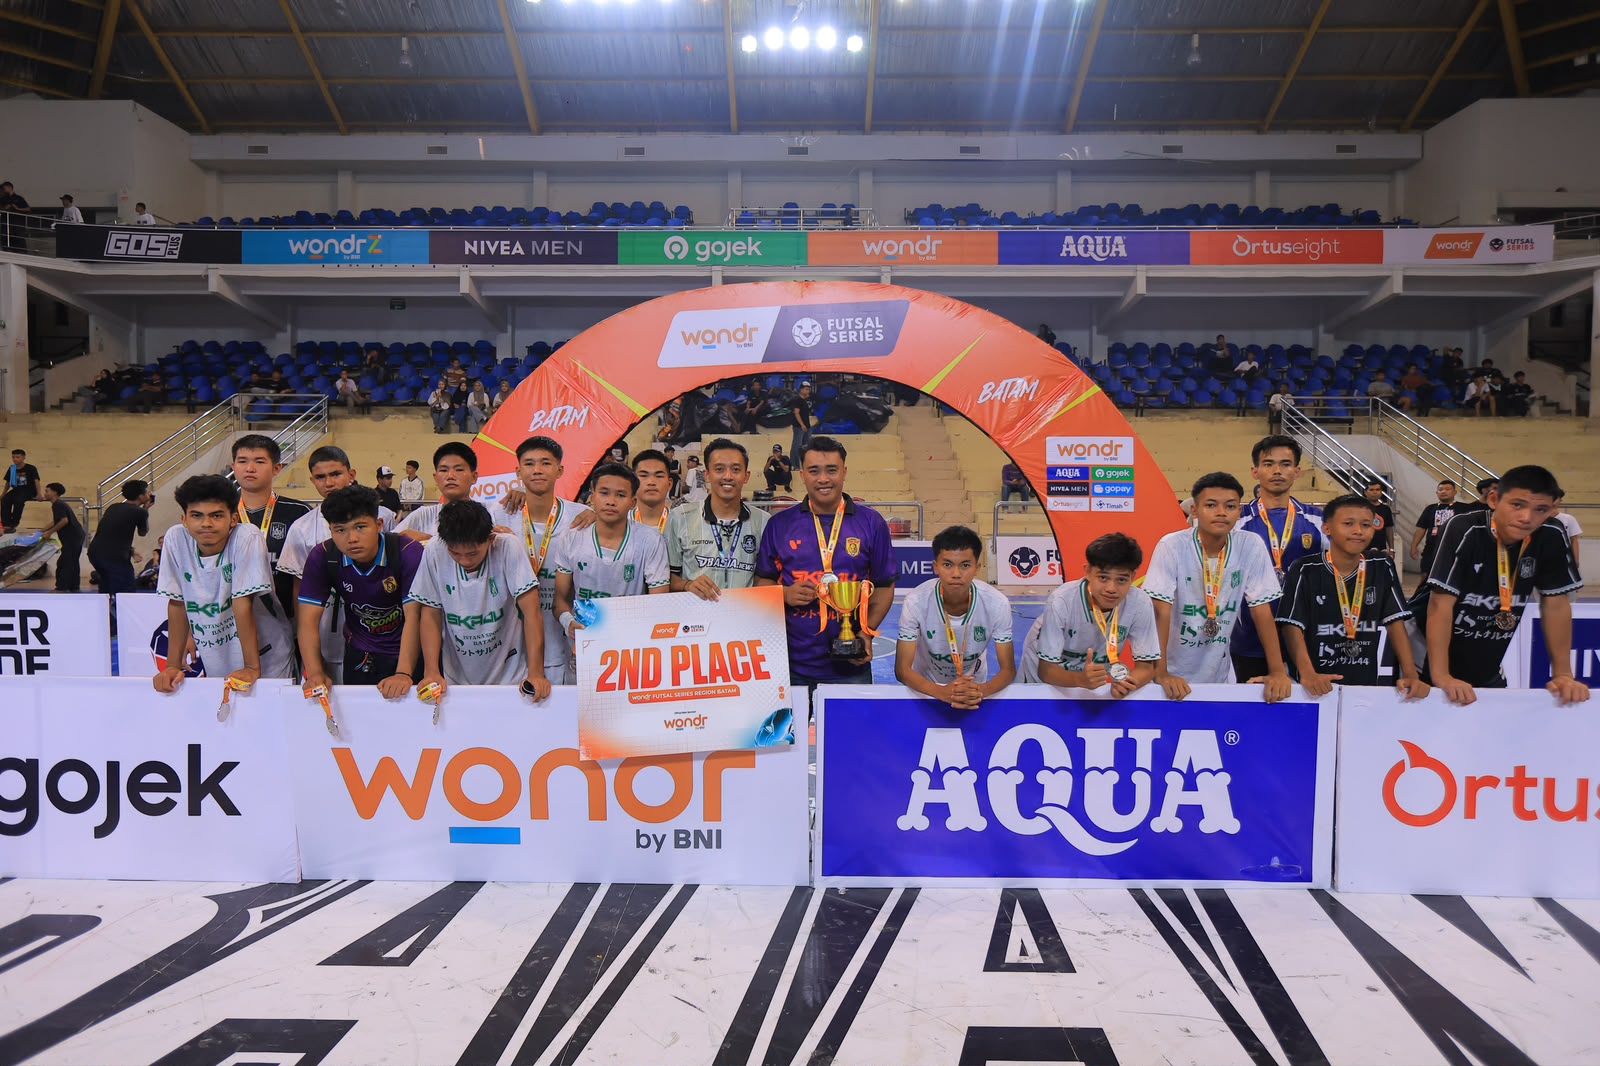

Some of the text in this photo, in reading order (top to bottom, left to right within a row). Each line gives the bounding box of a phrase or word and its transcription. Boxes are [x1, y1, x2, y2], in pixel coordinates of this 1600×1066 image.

[106, 233, 170, 256] GOS
[167, 236, 181, 256] PLUS
[464, 240, 583, 255] NIVEA MEN
[695, 237, 762, 262] gojek
[862, 235, 943, 255] wondr
[1060, 235, 1127, 261] AQUA
[1232, 235, 1341, 260] Ortuseight
[1436, 240, 1473, 250] wondr
[681, 322, 759, 346] wondr
[827, 316, 883, 331] FUTSAL
[828, 328, 884, 343] SERIES
[977, 377, 1040, 404] BATAM
[528, 404, 589, 432] BATAM
[1057, 440, 1123, 456] wondr
[1055, 468, 1081, 479] AQUA
[1106, 469, 1130, 478] gojek
[1105, 486, 1131, 494] gopay
[596, 639, 771, 692] 2ND PLACE
[717, 687, 737, 695] BATAM
[663, 714, 708, 729] wondr
[0, 744, 242, 839] gojek
[331, 747, 757, 824] wondr
[896, 723, 1241, 856] AQUA
[635, 829, 722, 854] by BNI
